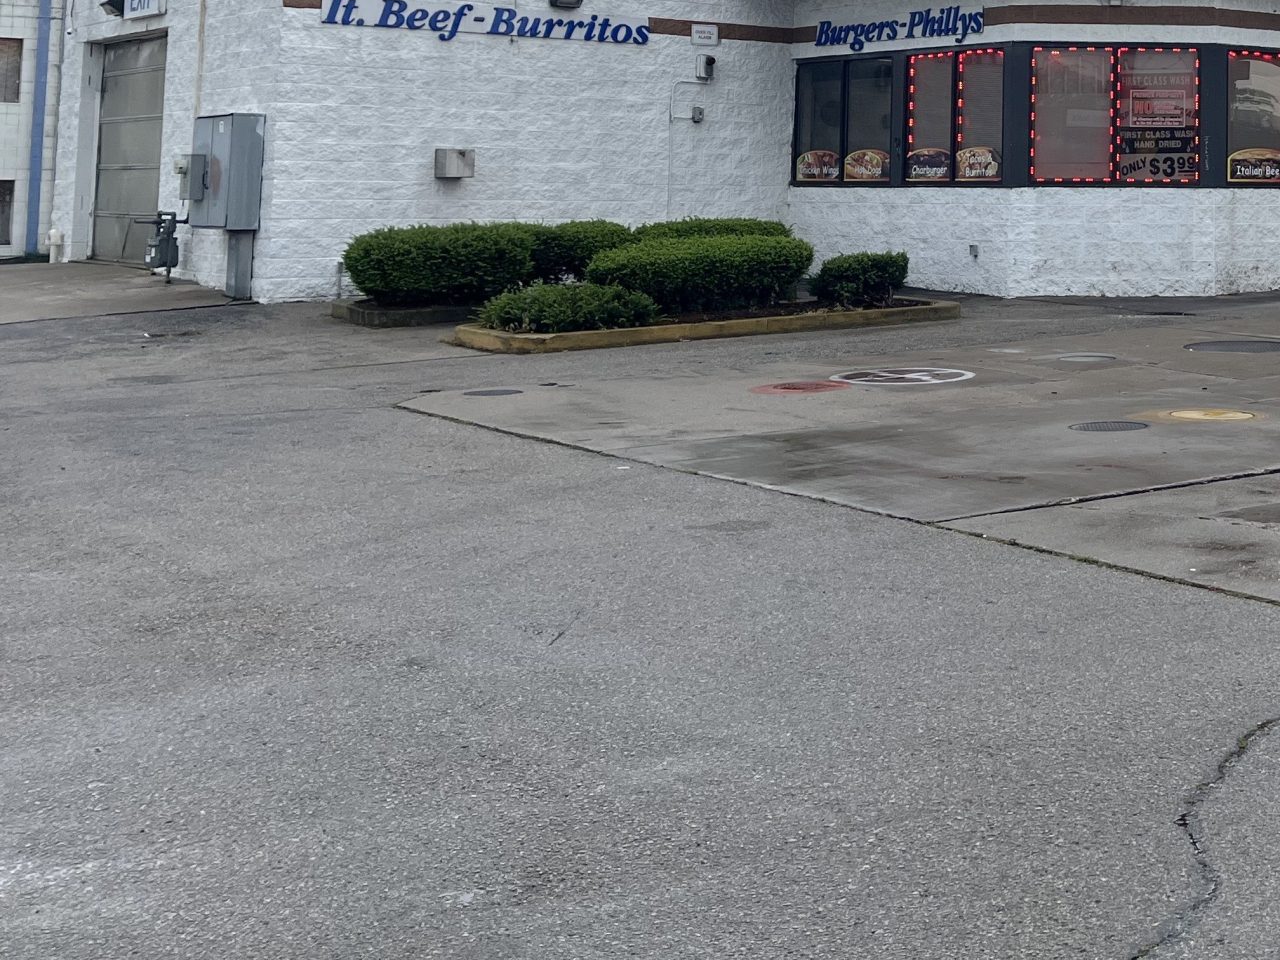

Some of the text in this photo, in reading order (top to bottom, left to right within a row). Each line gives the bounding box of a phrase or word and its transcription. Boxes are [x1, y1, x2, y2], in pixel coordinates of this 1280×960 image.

[815, 5, 985, 52] Burgers-Phillys
[1144, 75, 1167, 86] CLASS
[1145, 131, 1171, 139] CLASS
[1134, 140, 1182, 149] HAND DRIED
[1121, 156, 1148, 176] ONLY
[1236, 165, 1262, 176] Italian
